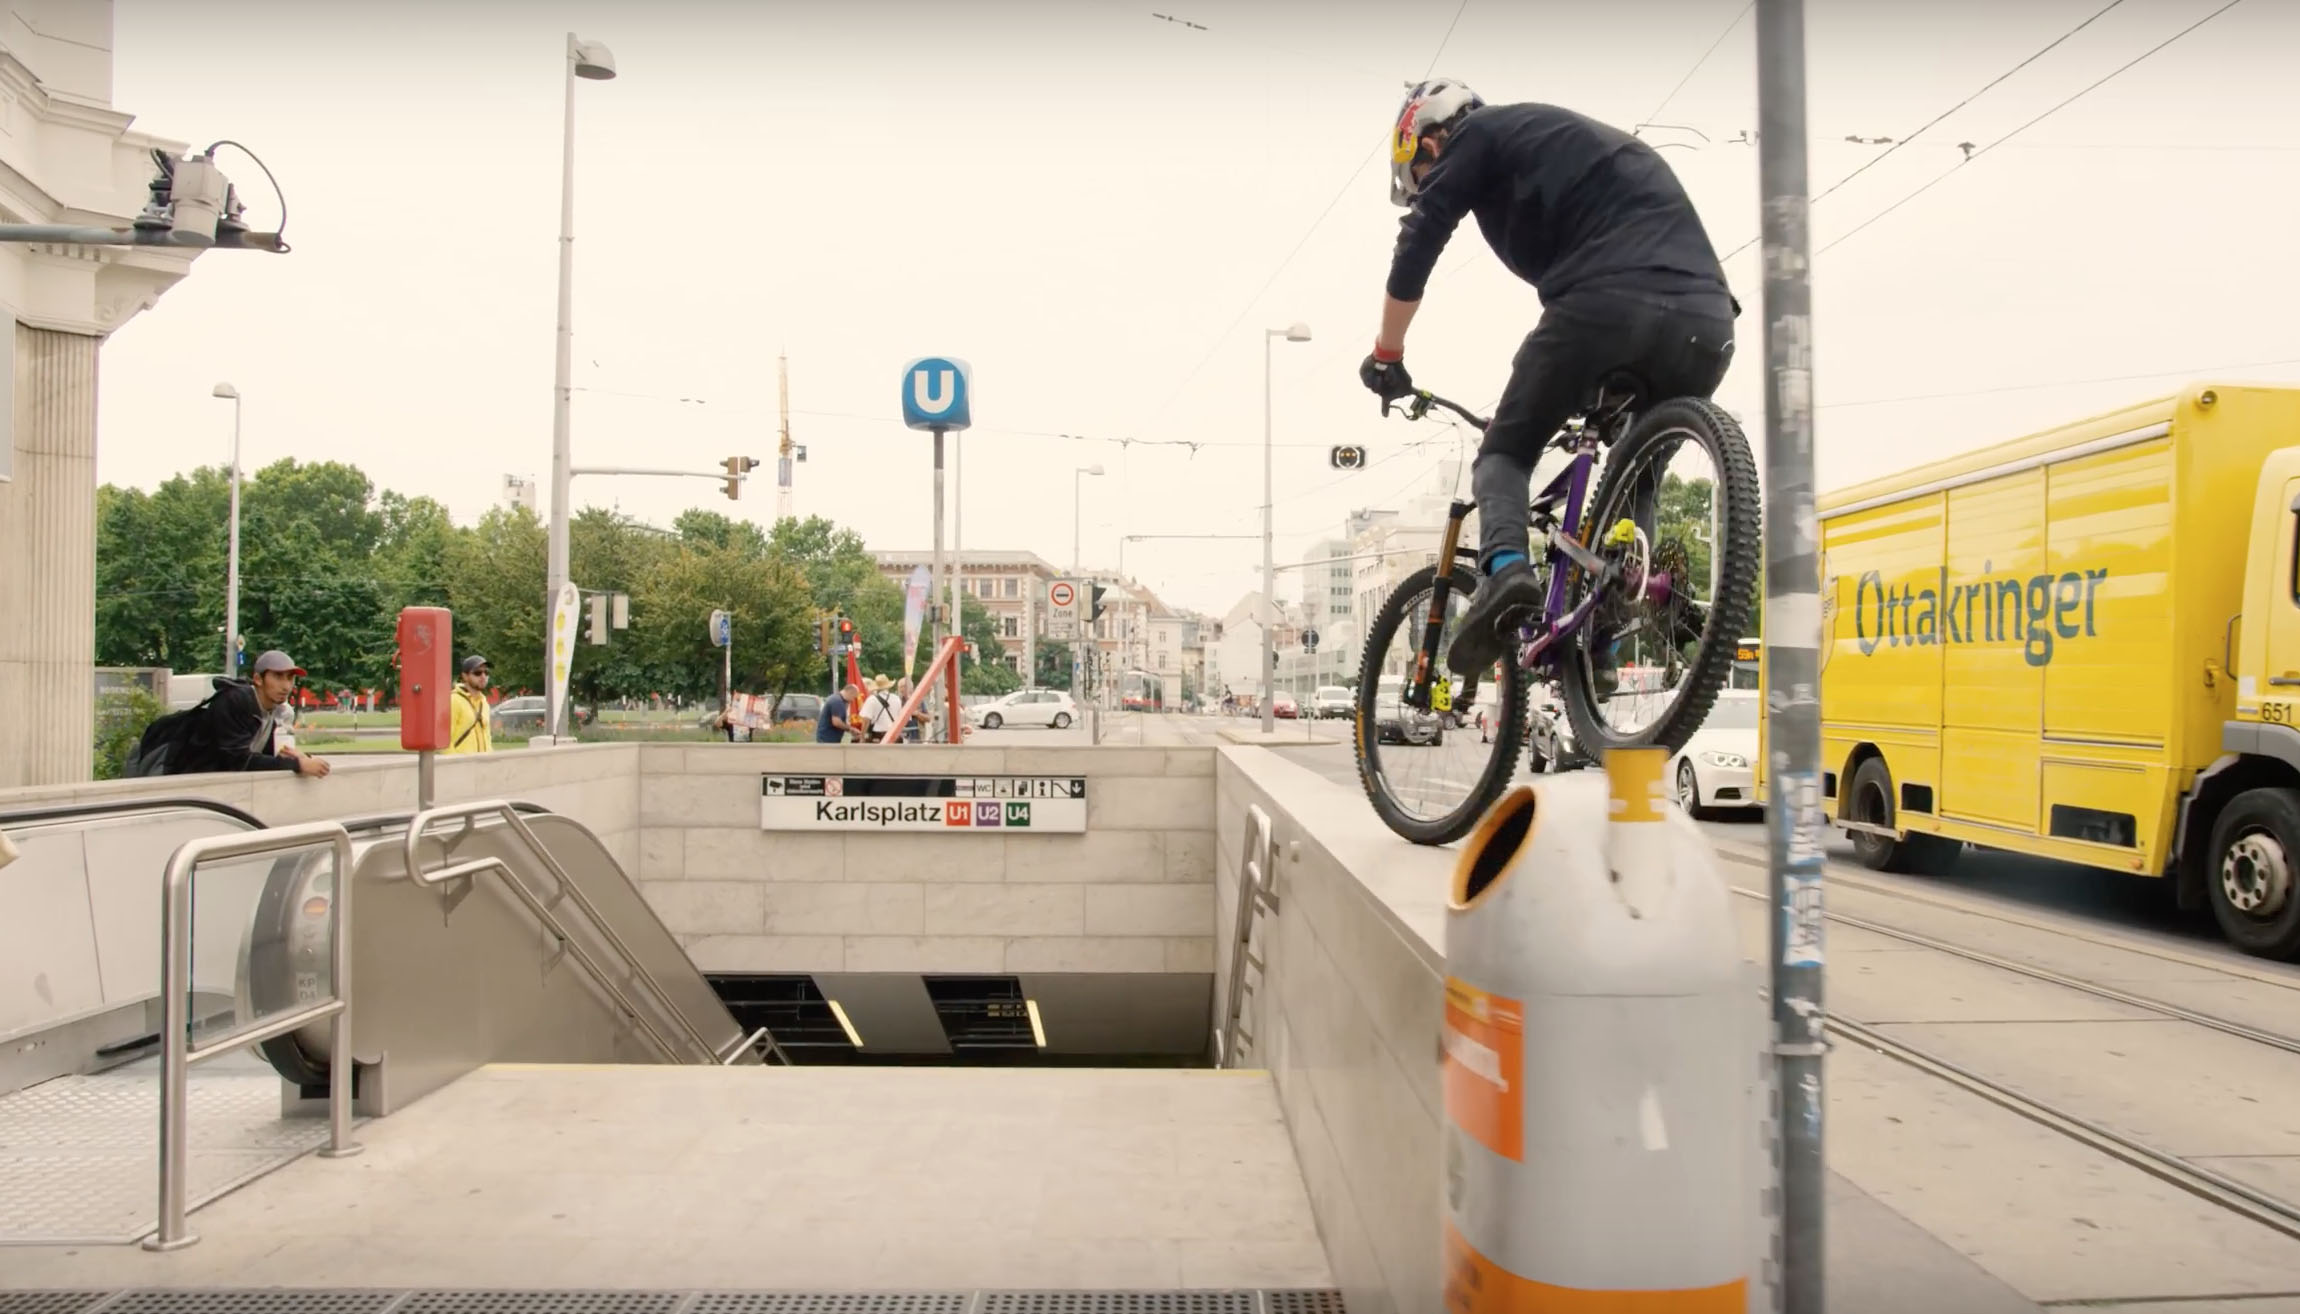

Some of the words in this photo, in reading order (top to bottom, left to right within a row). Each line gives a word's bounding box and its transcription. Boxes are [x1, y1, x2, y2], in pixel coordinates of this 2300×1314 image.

[914, 370, 954, 414] U
[1053, 608, 1073, 618] Zone
[1856, 559, 2108, 667] Ottakringer
[2262, 702, 2292, 724] 651
[976, 784, 992, 793] WC
[816, 801, 941, 826] Karlsplatz
[949, 806, 969, 821] U1
[977, 806, 999, 821] U2
[1007, 806, 1030, 821] U4
